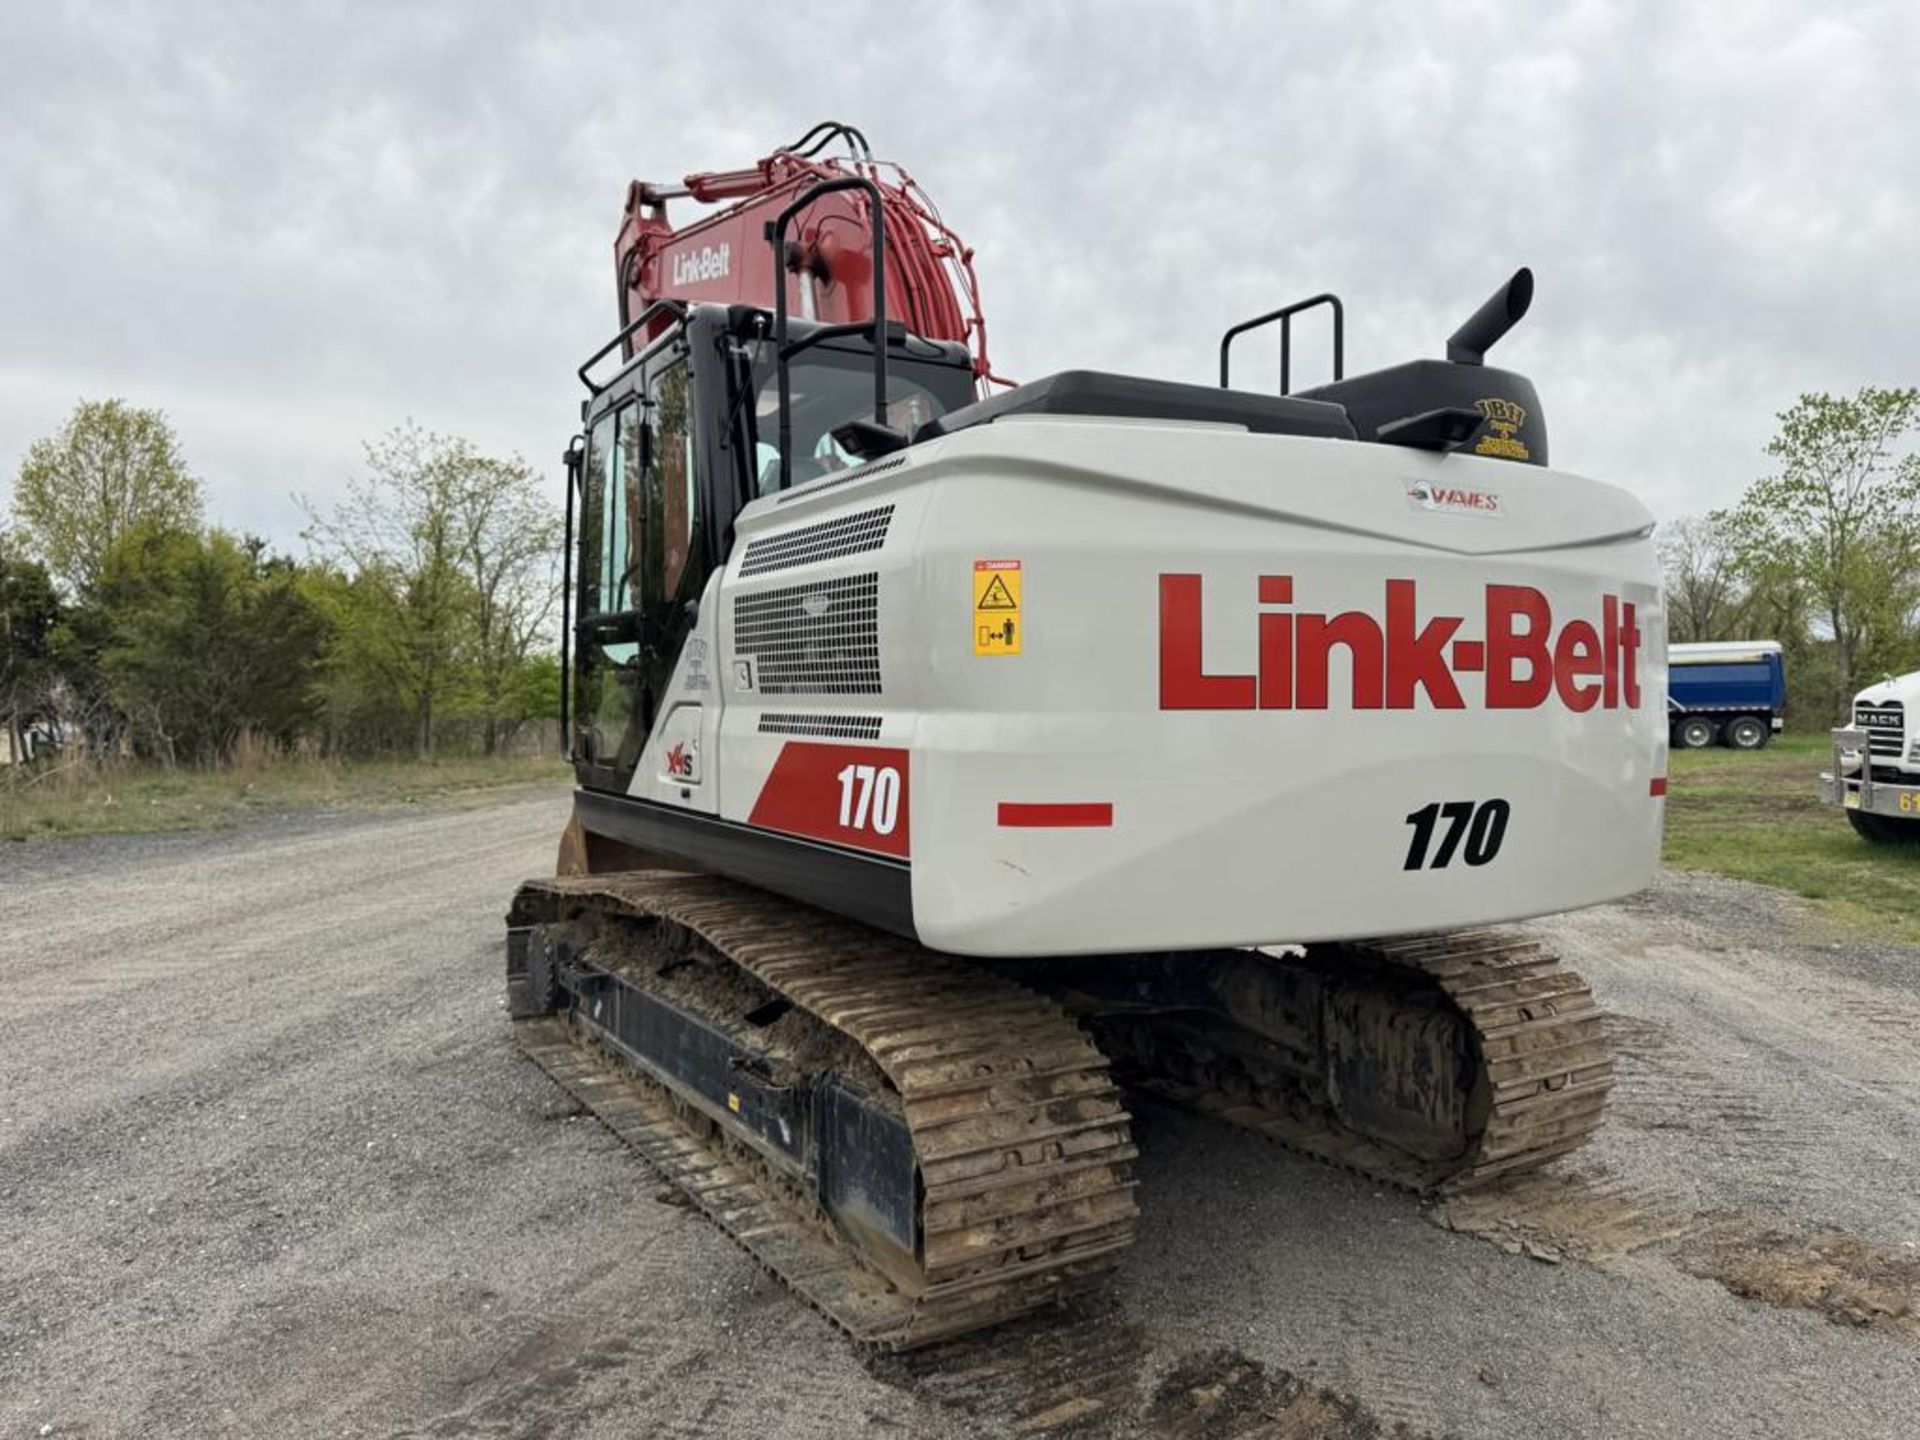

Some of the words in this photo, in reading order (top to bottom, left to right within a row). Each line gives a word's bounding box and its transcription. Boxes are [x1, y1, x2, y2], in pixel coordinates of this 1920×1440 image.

[673, 242, 730, 286] Link-Belt
[1159, 573, 1641, 713] Link-Belt
[1857, 713, 1901, 726] MACK
[838, 764, 900, 835] 170
[1403, 798, 1511, 871] 170
